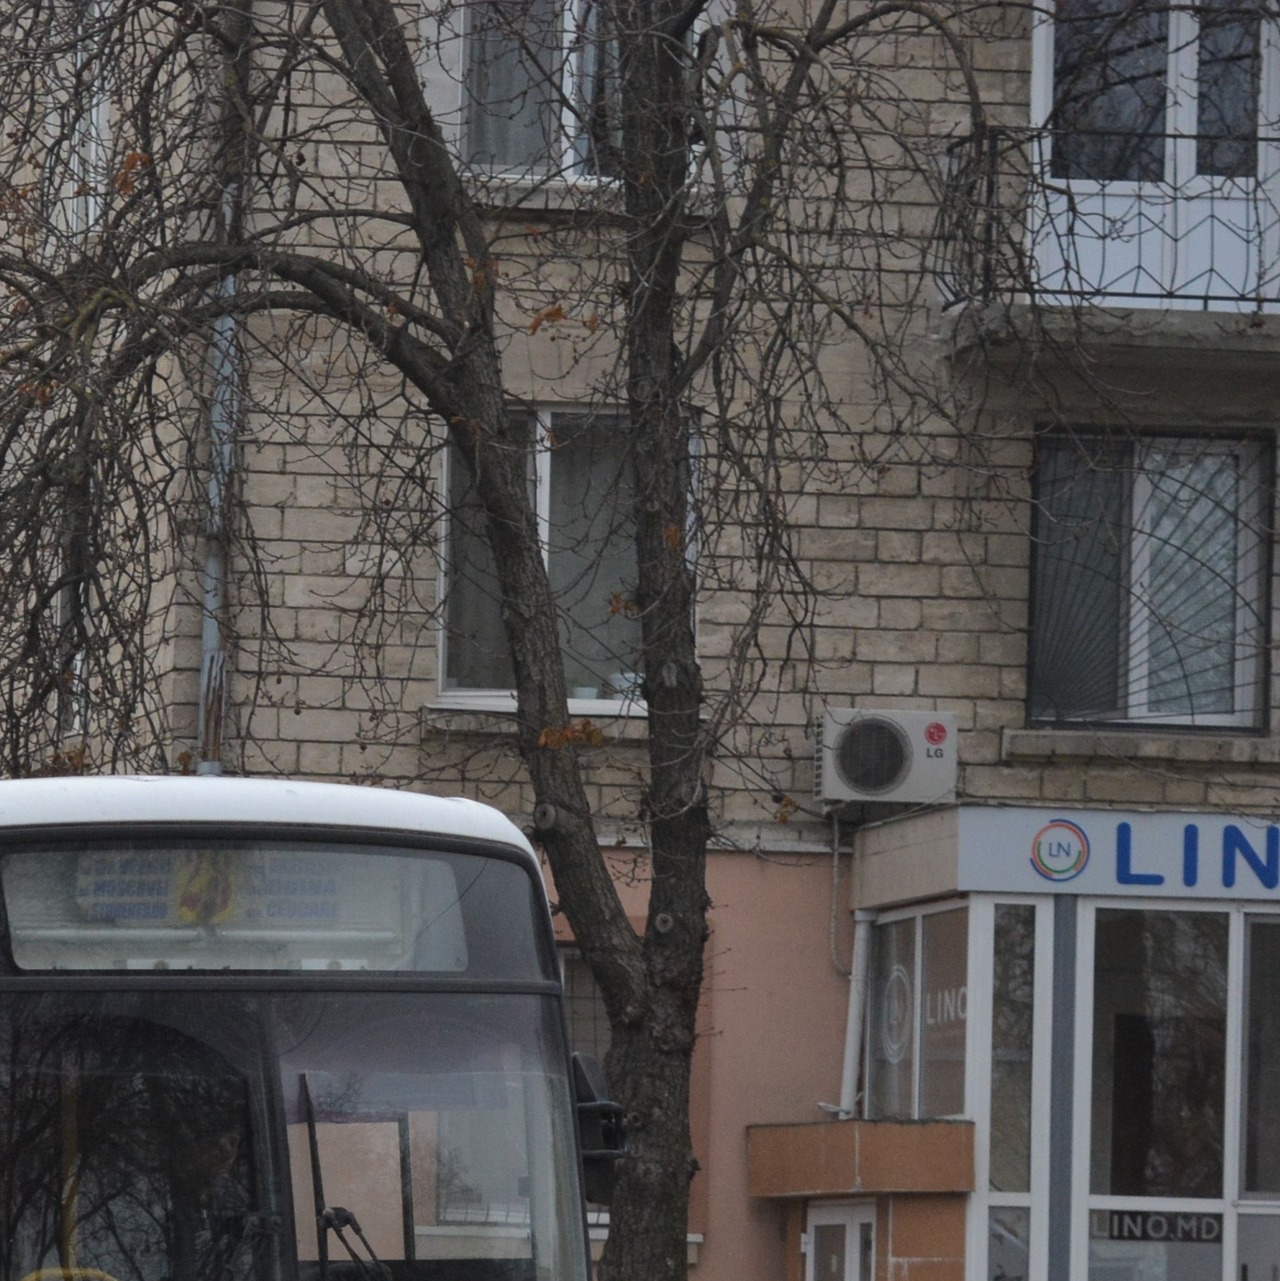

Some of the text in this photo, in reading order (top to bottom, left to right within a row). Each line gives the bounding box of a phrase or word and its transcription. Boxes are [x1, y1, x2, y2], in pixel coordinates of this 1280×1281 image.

[926, 747, 944, 758] LG
[1116, 821, 1280, 889] LIN
[1092, 1213, 1220, 1240] LINO.MD
